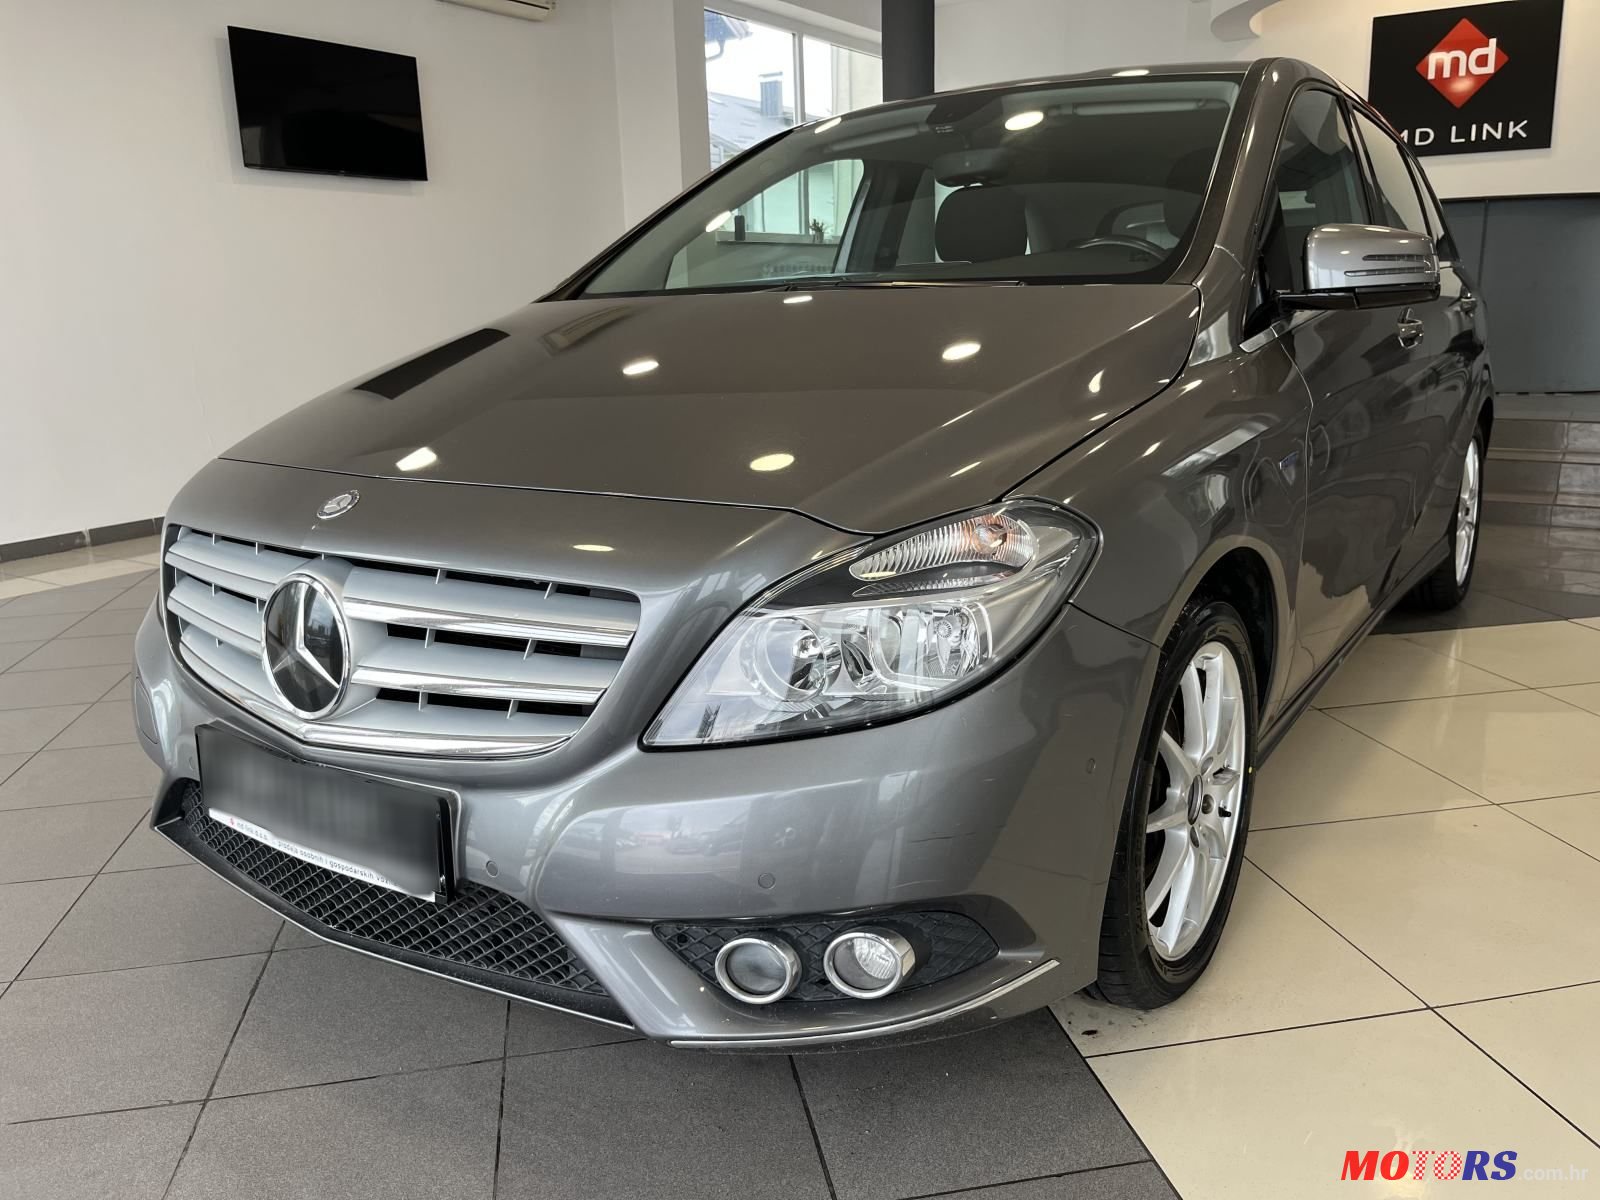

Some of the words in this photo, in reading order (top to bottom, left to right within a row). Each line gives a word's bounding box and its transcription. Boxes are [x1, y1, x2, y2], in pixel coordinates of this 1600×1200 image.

[1427, 38, 1497, 80] md
[1450, 119, 1528, 143] LINK
[329, 858, 374, 879] gospodarskih
